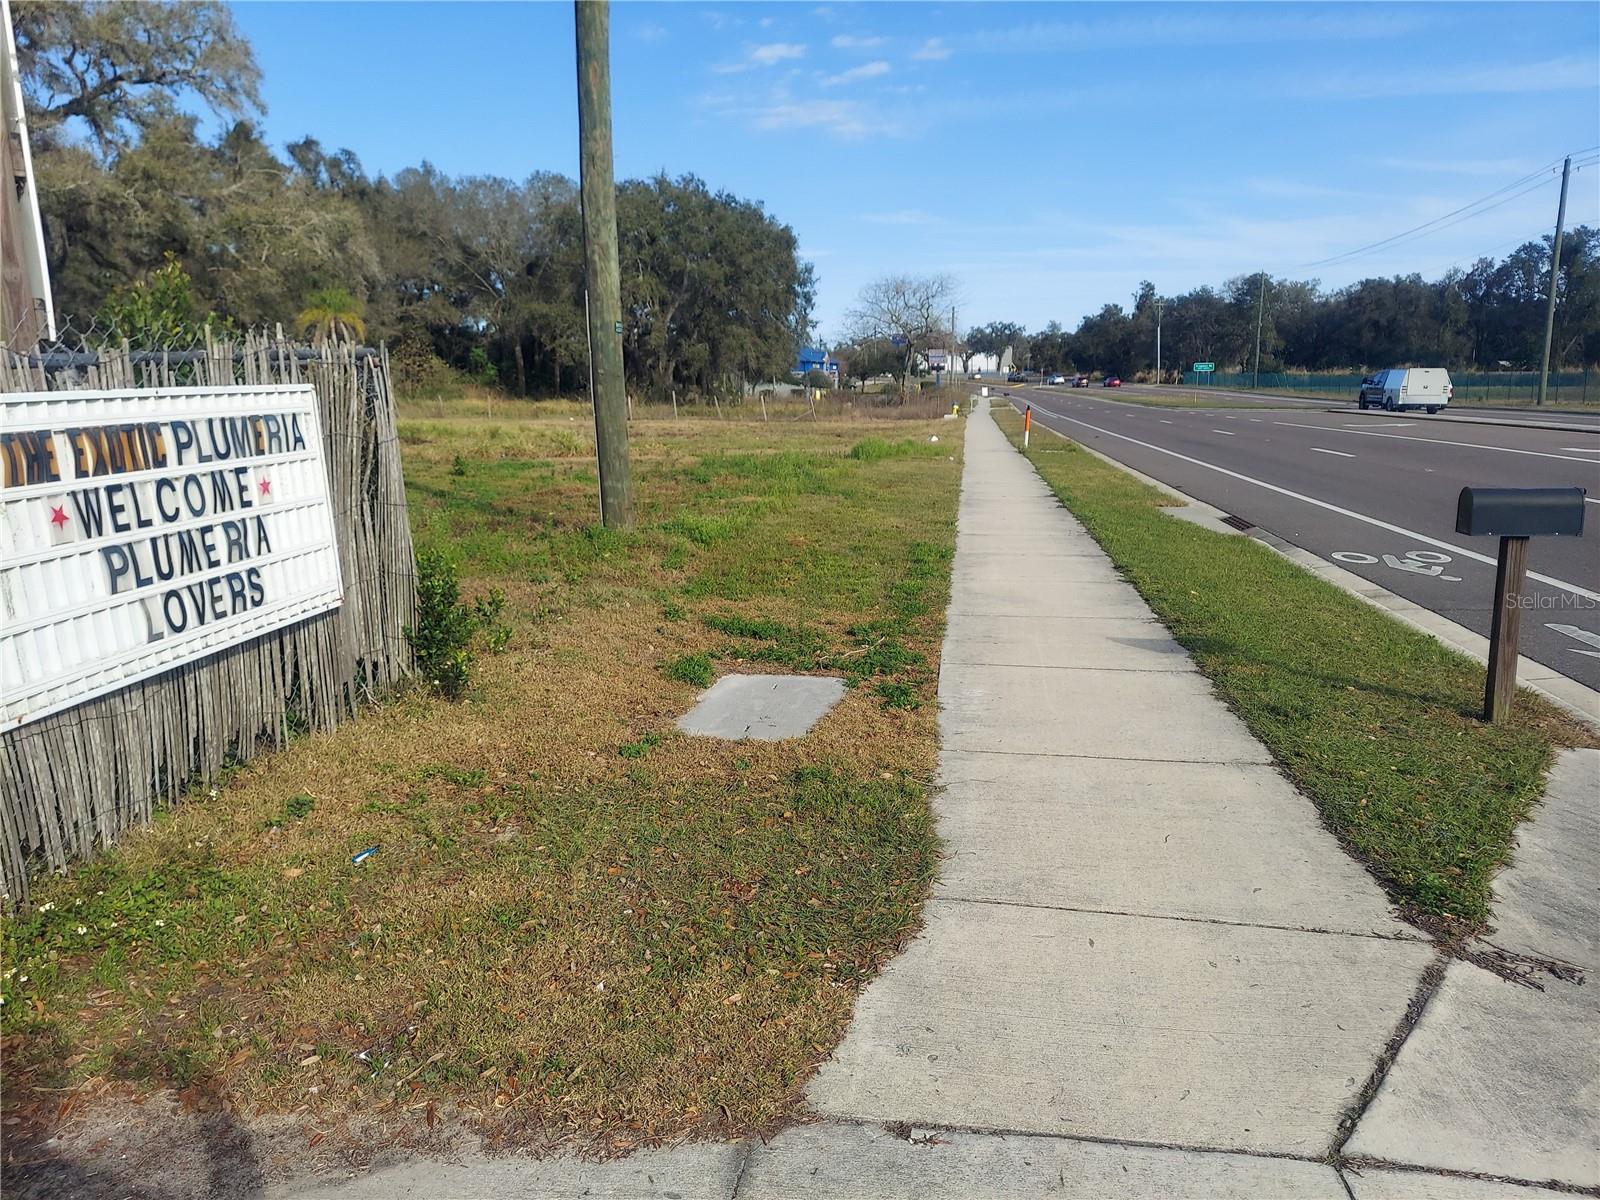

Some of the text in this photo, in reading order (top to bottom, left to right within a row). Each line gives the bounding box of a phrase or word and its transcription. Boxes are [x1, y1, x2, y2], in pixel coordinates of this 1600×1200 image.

[0, 412, 306, 488] THE EXOTIC PLUMERIA
[69, 466, 253, 539] WELCOME
[100, 515, 272, 595] PLUMERIA
[140, 567, 265, 643] LOVERS
